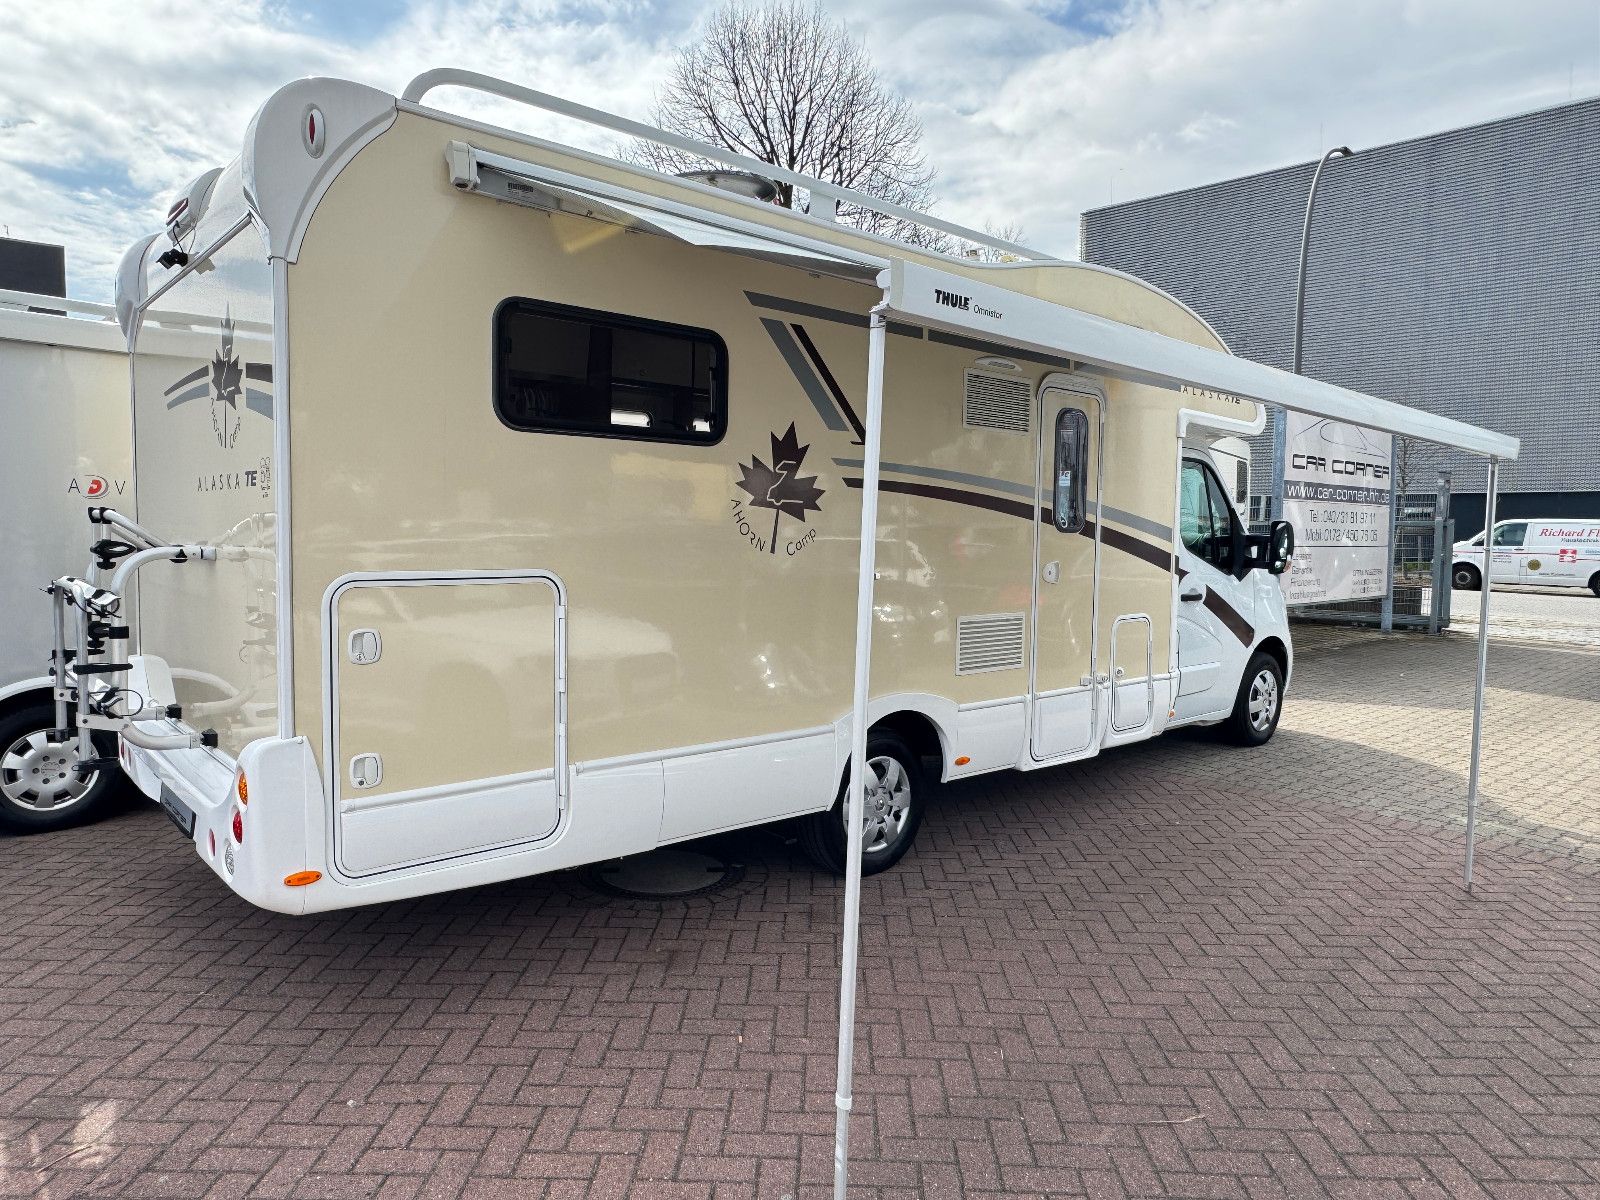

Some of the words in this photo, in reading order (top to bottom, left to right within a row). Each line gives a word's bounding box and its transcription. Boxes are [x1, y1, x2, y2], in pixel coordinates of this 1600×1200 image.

[934, 288, 970, 311] THULE
[973, 304, 1003, 320] Omnistor
[1292, 453, 1327, 473] CAR
[1331, 459, 1390, 480] CORNER
[197, 472, 241, 492] ALASKA
[244, 470, 258, 487] TE
[730, 499, 766, 552] AHORN
[786, 528, 817, 556] Camp
[1539, 528, 1585, 537] Richard
